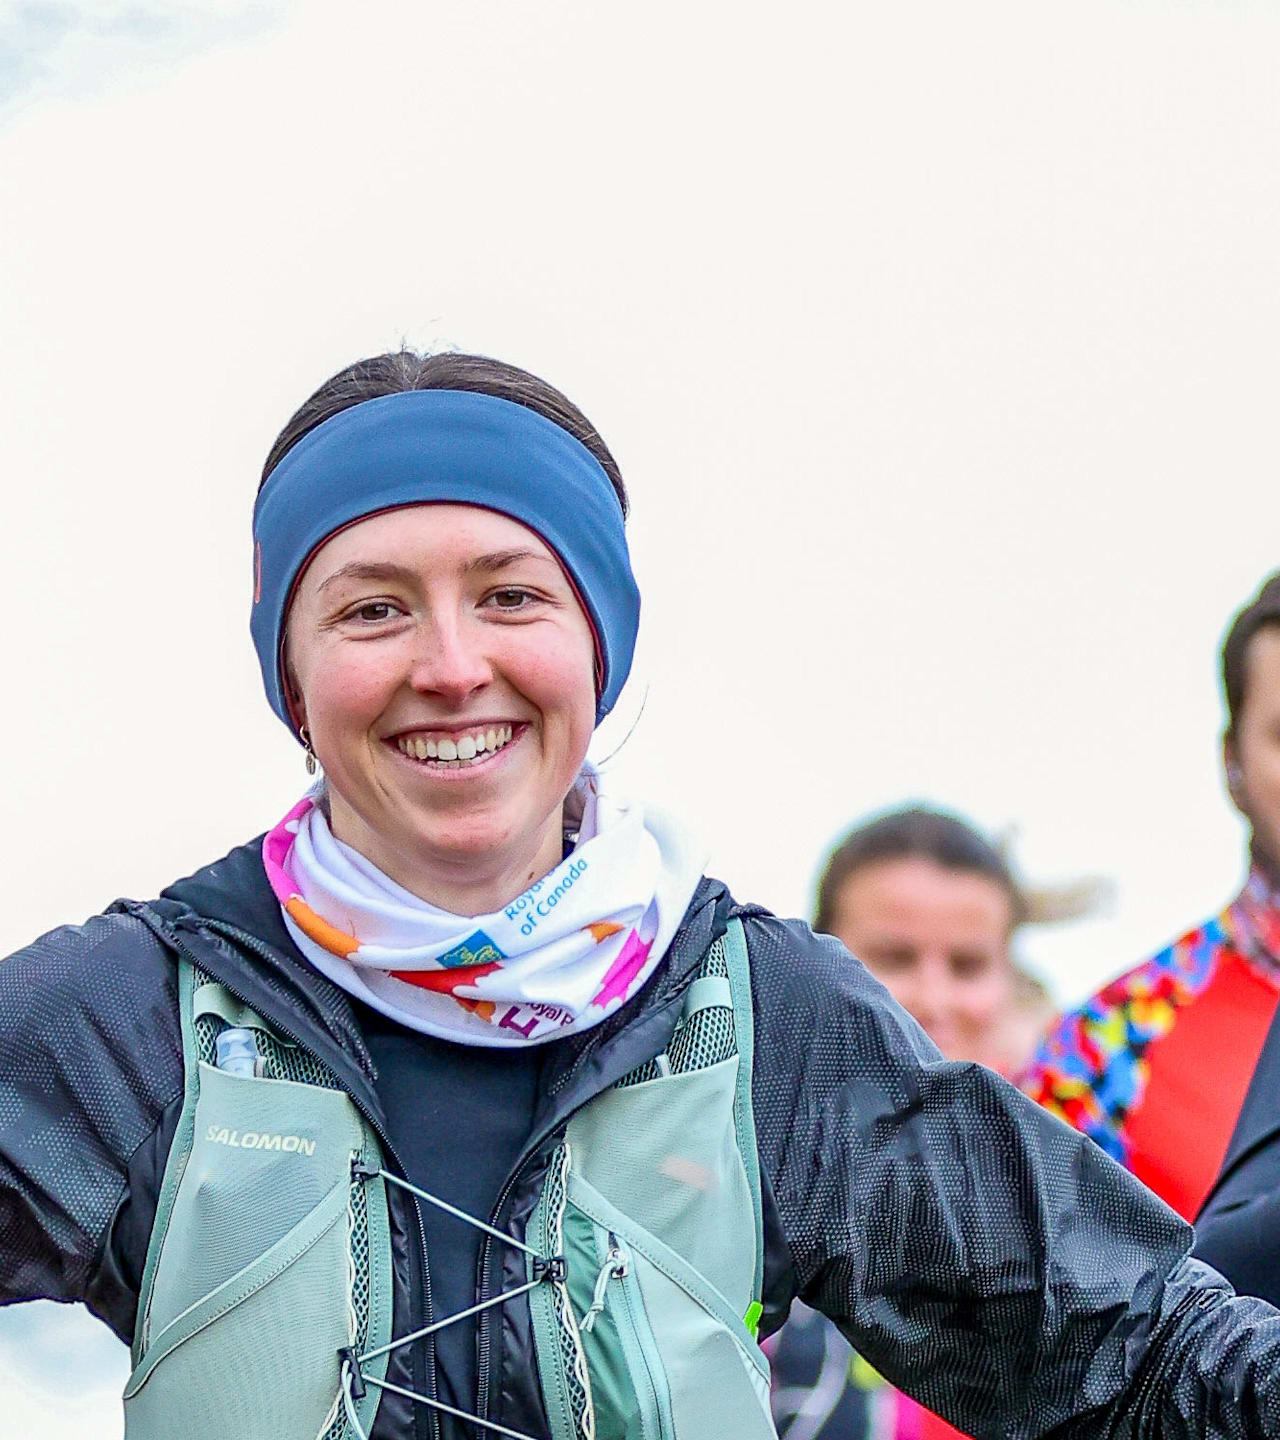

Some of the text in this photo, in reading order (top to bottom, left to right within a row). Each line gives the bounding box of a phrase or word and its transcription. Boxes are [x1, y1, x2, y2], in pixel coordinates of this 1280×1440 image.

[520, 858, 588, 935] of Canada
[526, 1003, 563, 1022] oyal
[206, 1125, 316, 1157] SALOMON
